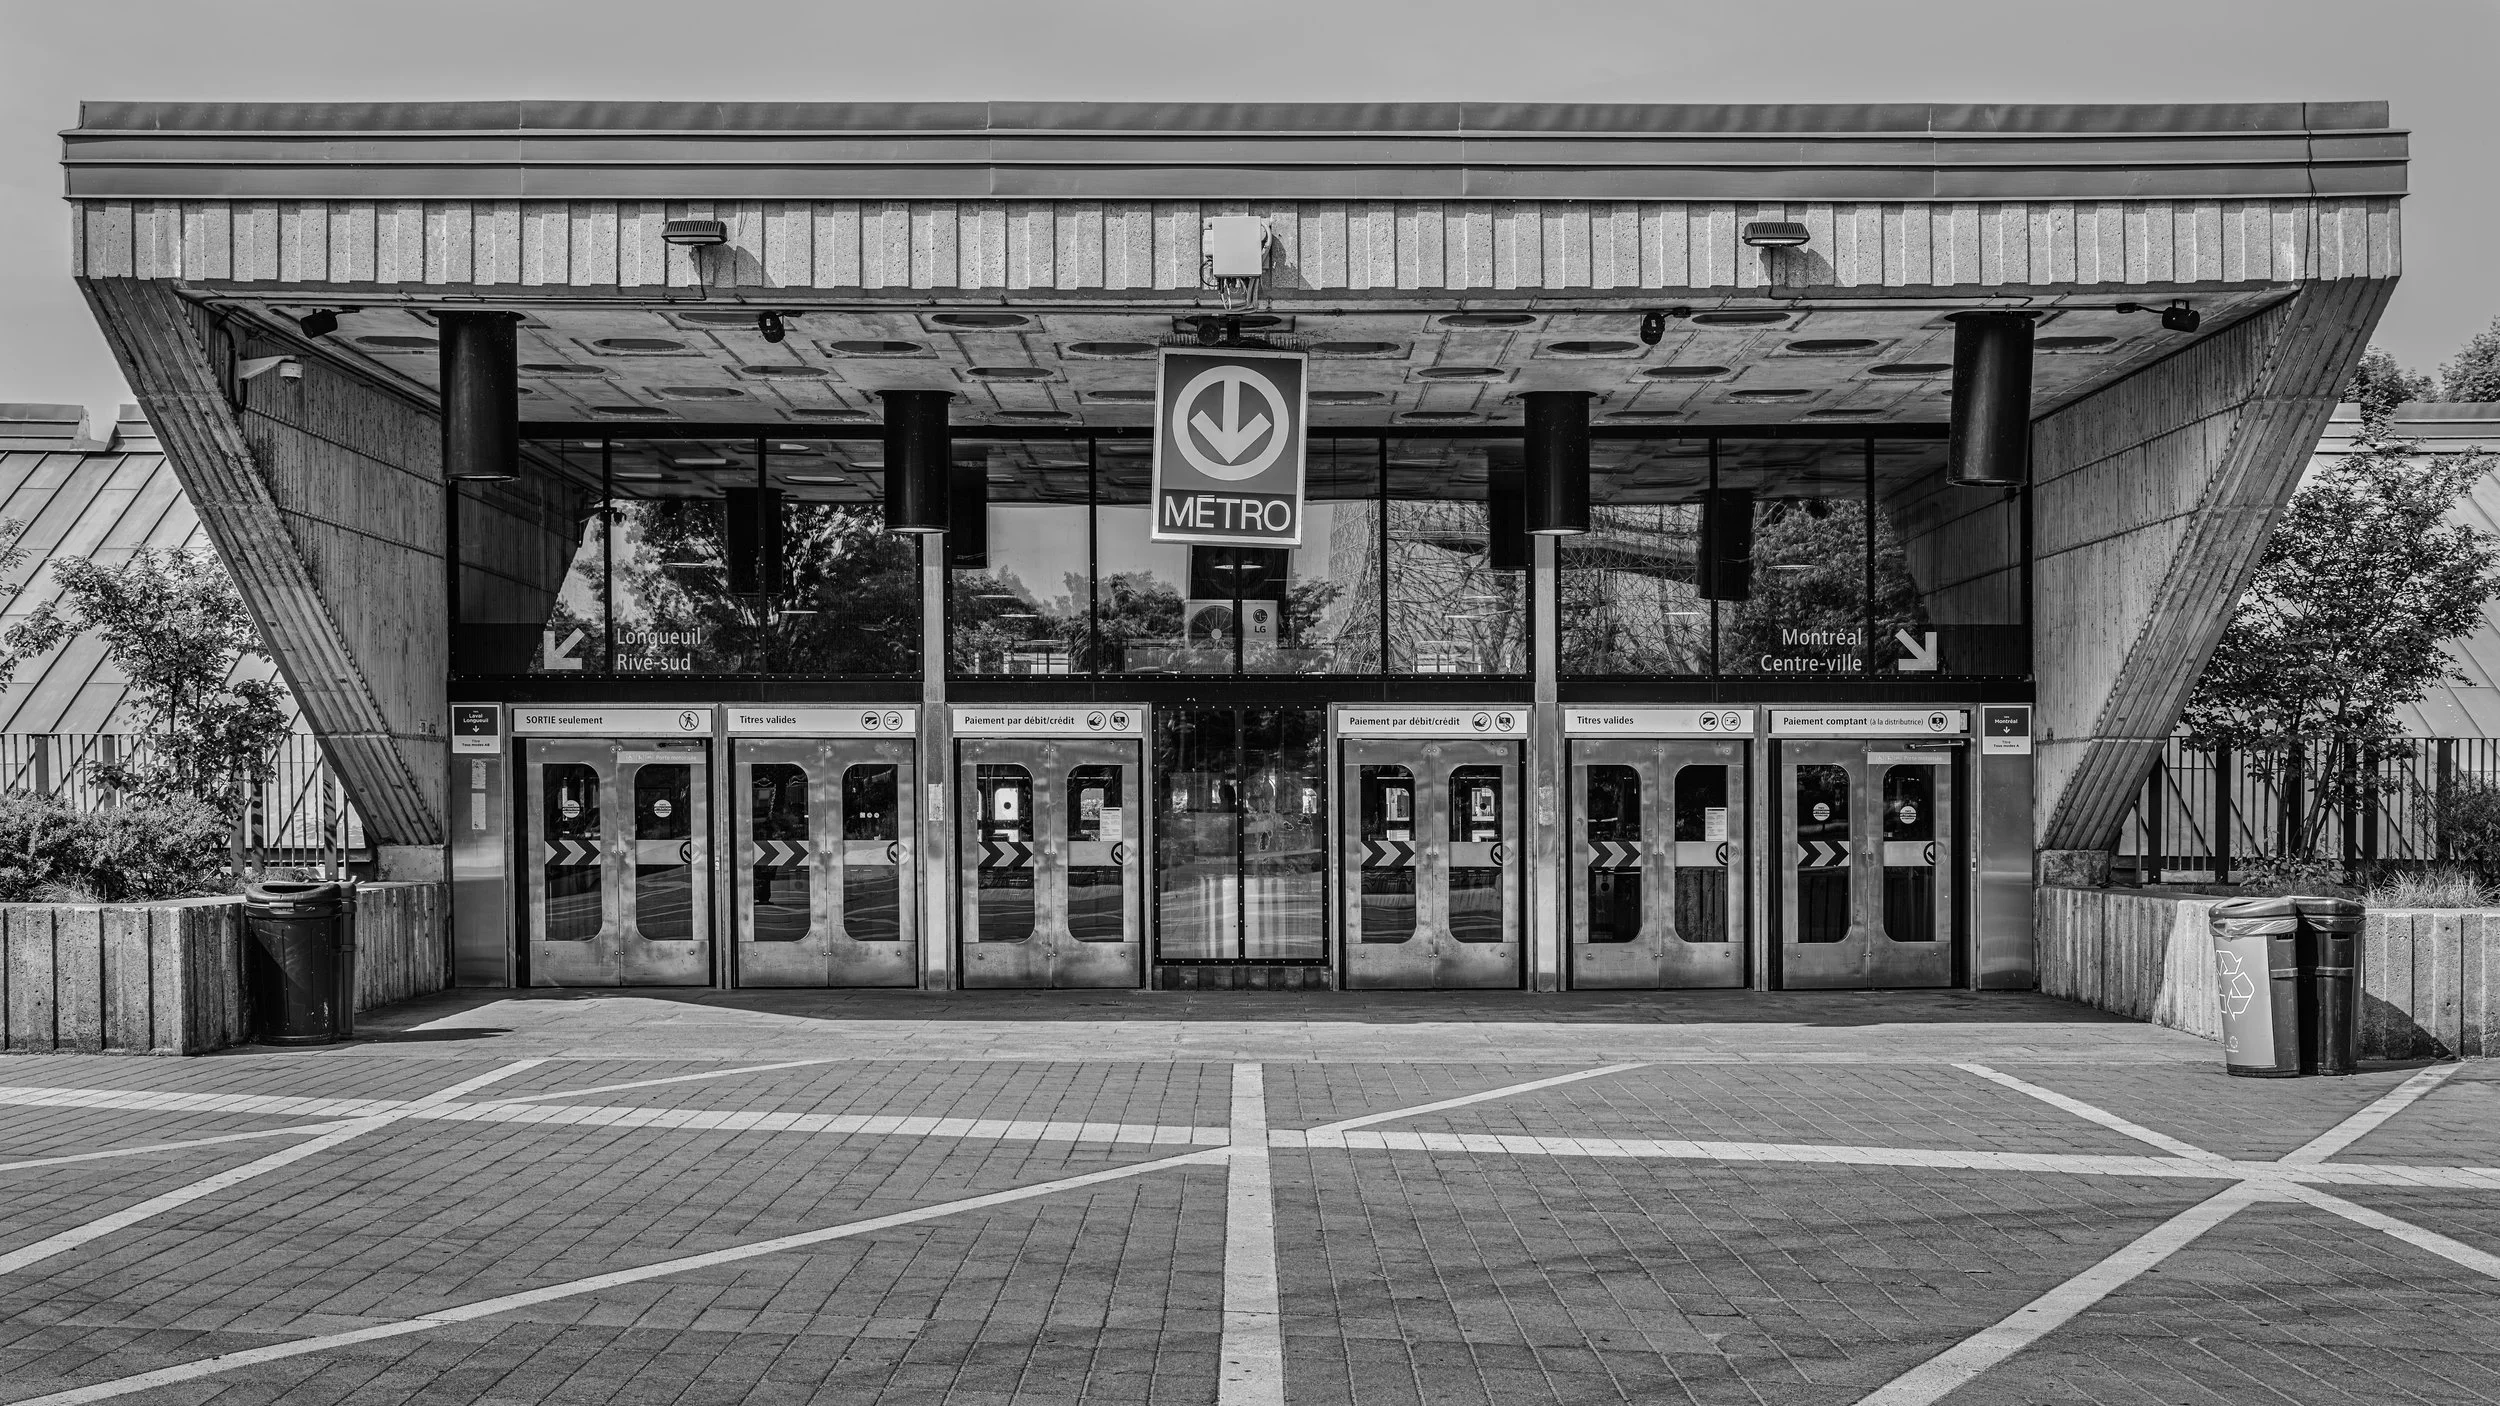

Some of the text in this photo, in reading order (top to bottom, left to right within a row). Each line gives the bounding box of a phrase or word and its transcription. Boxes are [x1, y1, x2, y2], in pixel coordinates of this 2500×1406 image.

[1254, 625, 1267, 634] LG
[617, 626, 701, 649] Longueuil
[1782, 627, 1862, 645] Montréal
[617, 652, 691, 671] Rive-sud
[1761, 653, 1862, 671] Centre-ville
[526, 715, 603, 725] SORTIE seulement
[739, 715, 797, 724] Titres valides
[964, 715, 1075, 727] Paiement par débit/crédit
[1349, 716, 1460, 728] Paiement par débit/crédit
[1576, 715, 1634, 725] Titres valides
[1783, 716, 1824, 726] Paiement
[1825, 716, 1868, 727] comptant
